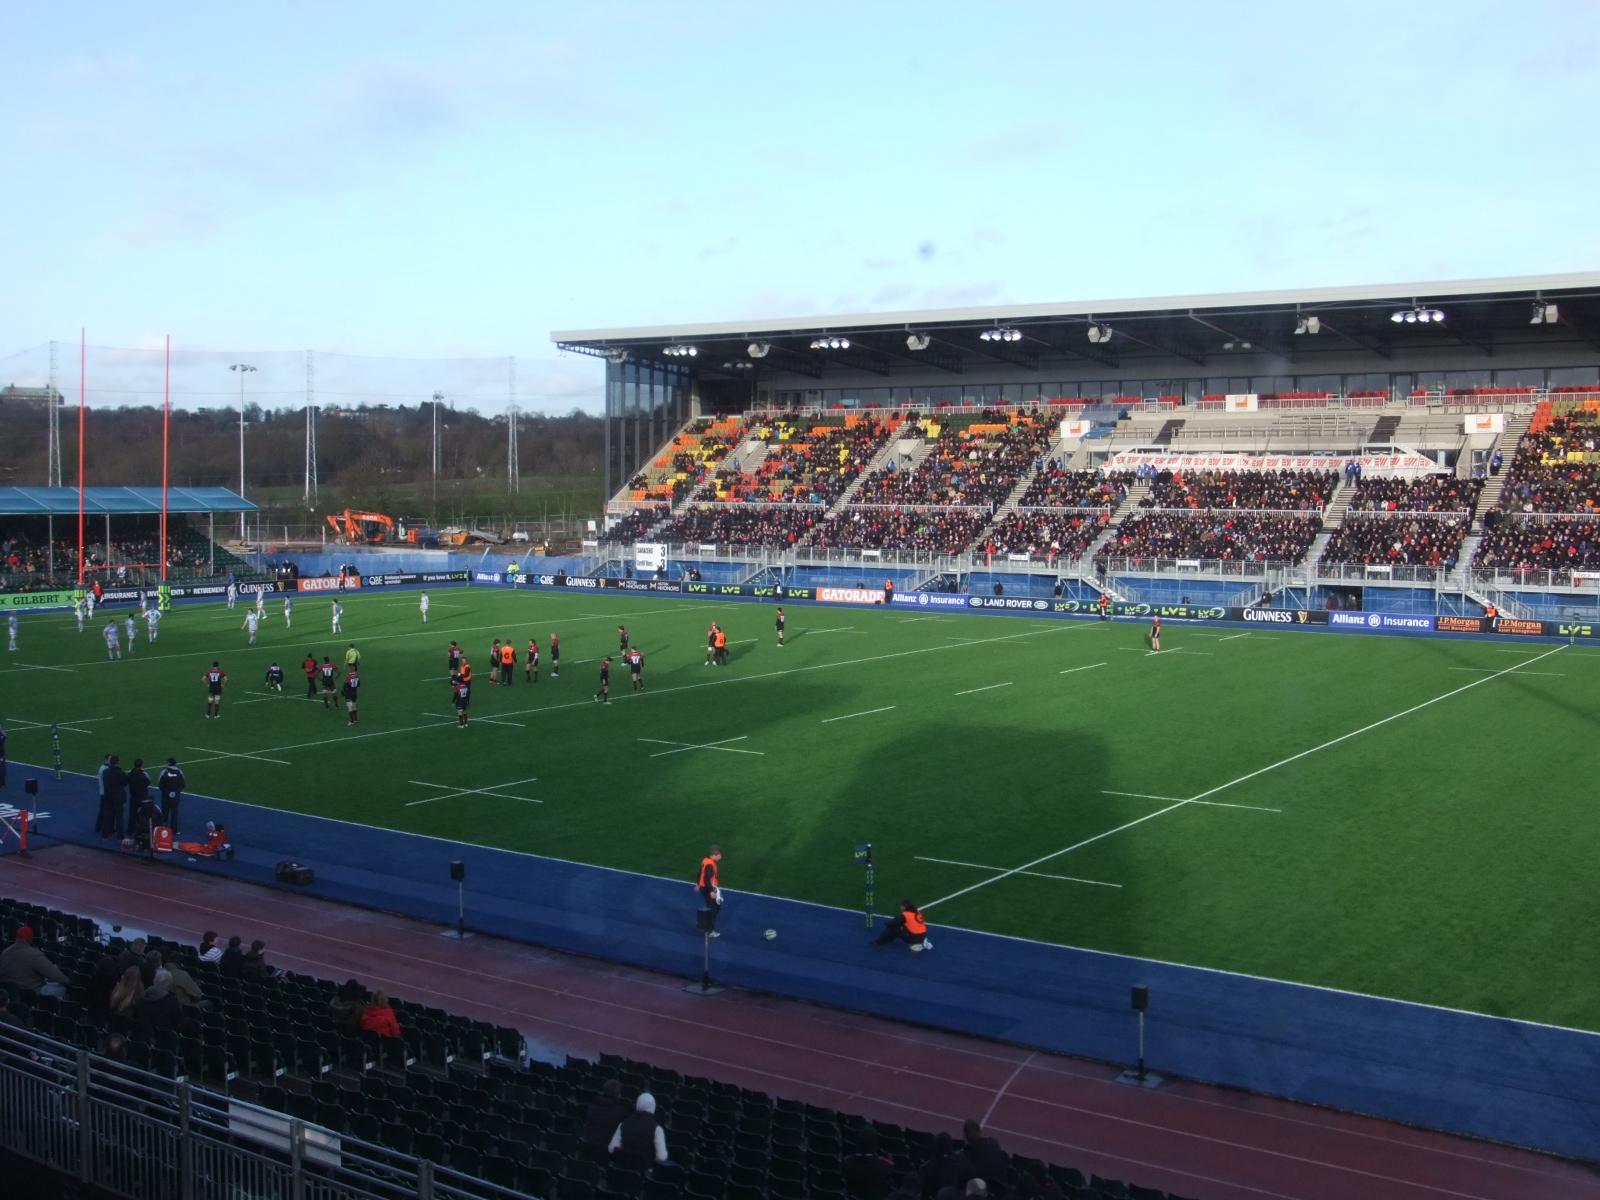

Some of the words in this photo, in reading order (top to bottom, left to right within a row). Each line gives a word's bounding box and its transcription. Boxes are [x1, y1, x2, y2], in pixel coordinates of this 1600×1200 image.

[660, 545, 666, 558] 3
[368, 575, 383, 586] QBE
[540, 575, 554, 585] QBE
[566, 576, 596, 588] GUINNESS
[193, 586, 226, 595] RETIREMENT
[822, 588, 886, 601] GATORADE
[13, 595, 60, 605] GILBERT
[892, 593, 917, 603] Allianz
[930, 596, 965, 605] Insurance
[984, 598, 1005, 607] LAND
[1006, 599, 1032, 609] ROVER
[1243, 608, 1292, 623] GUINNESS
[1332, 613, 1365, 624] Allianz
[1384, 616, 1430, 627] Insurance
